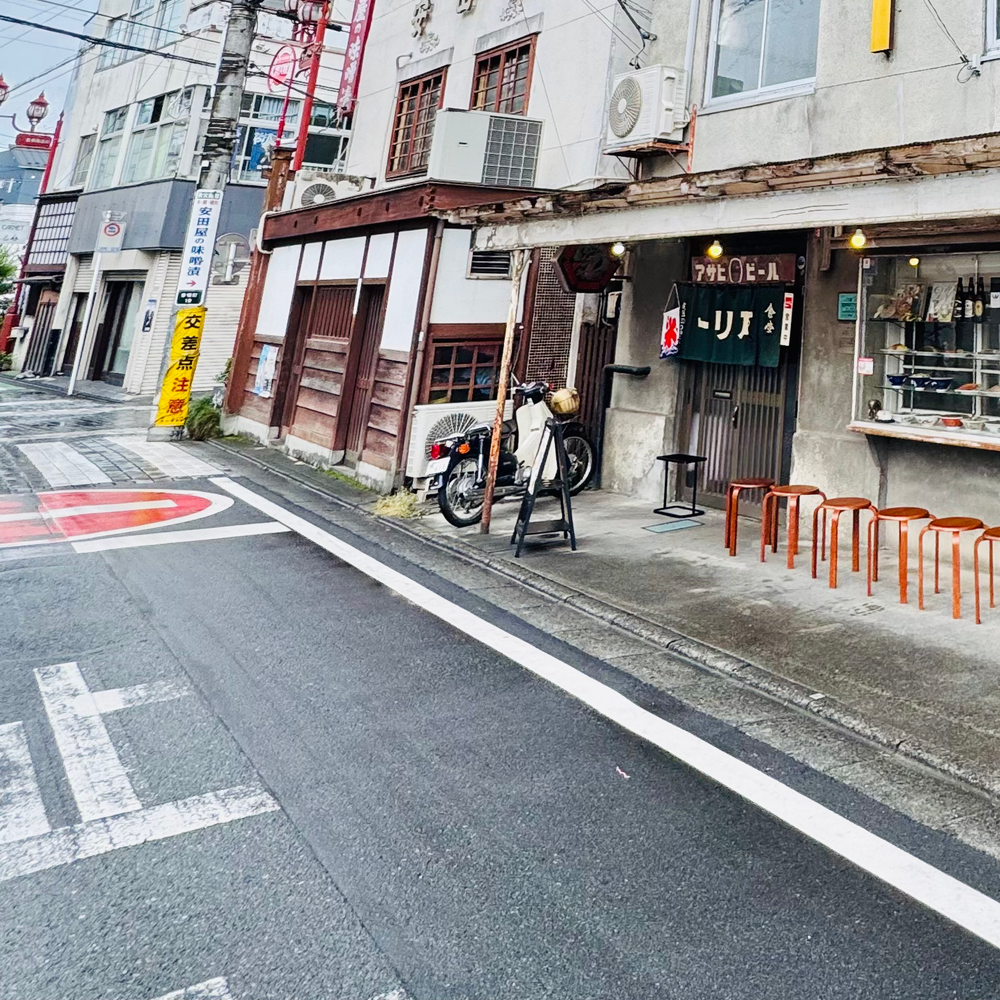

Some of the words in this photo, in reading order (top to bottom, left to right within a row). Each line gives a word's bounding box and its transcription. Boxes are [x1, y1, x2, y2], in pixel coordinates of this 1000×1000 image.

[187, 206, 213, 277] 安田屋の味噌漬
[166, 313, 203, 415] 交差点注意
